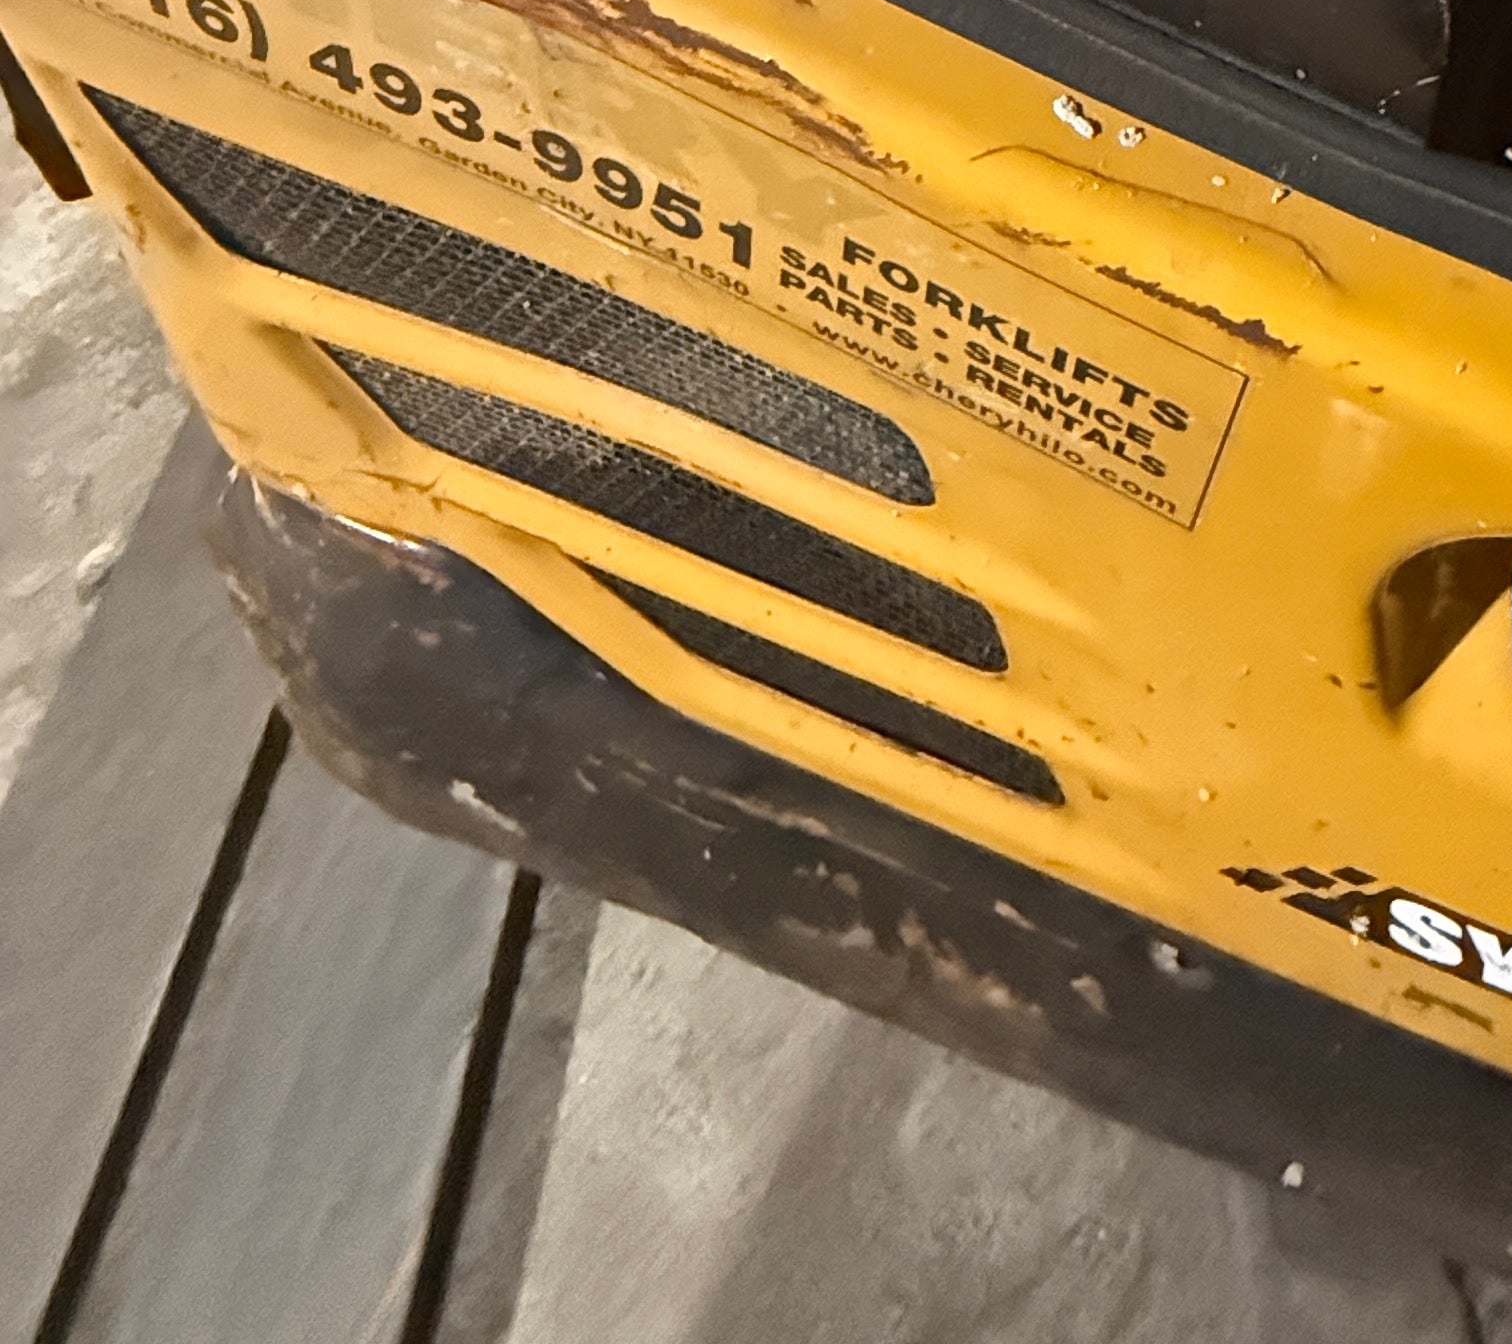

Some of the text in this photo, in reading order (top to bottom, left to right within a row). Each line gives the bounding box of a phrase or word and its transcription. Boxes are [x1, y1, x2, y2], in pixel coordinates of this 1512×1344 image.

[309, 43, 753, 270] 493-9951
[418, 137, 528, 192] Garden
[613, 219, 656, 247] NY
[779, 268, 1167, 478] PARTS RENTALS
[780, 245, 1155, 450] SALES SERVICE
[842, 236, 1190, 432] FORKLIFTS
